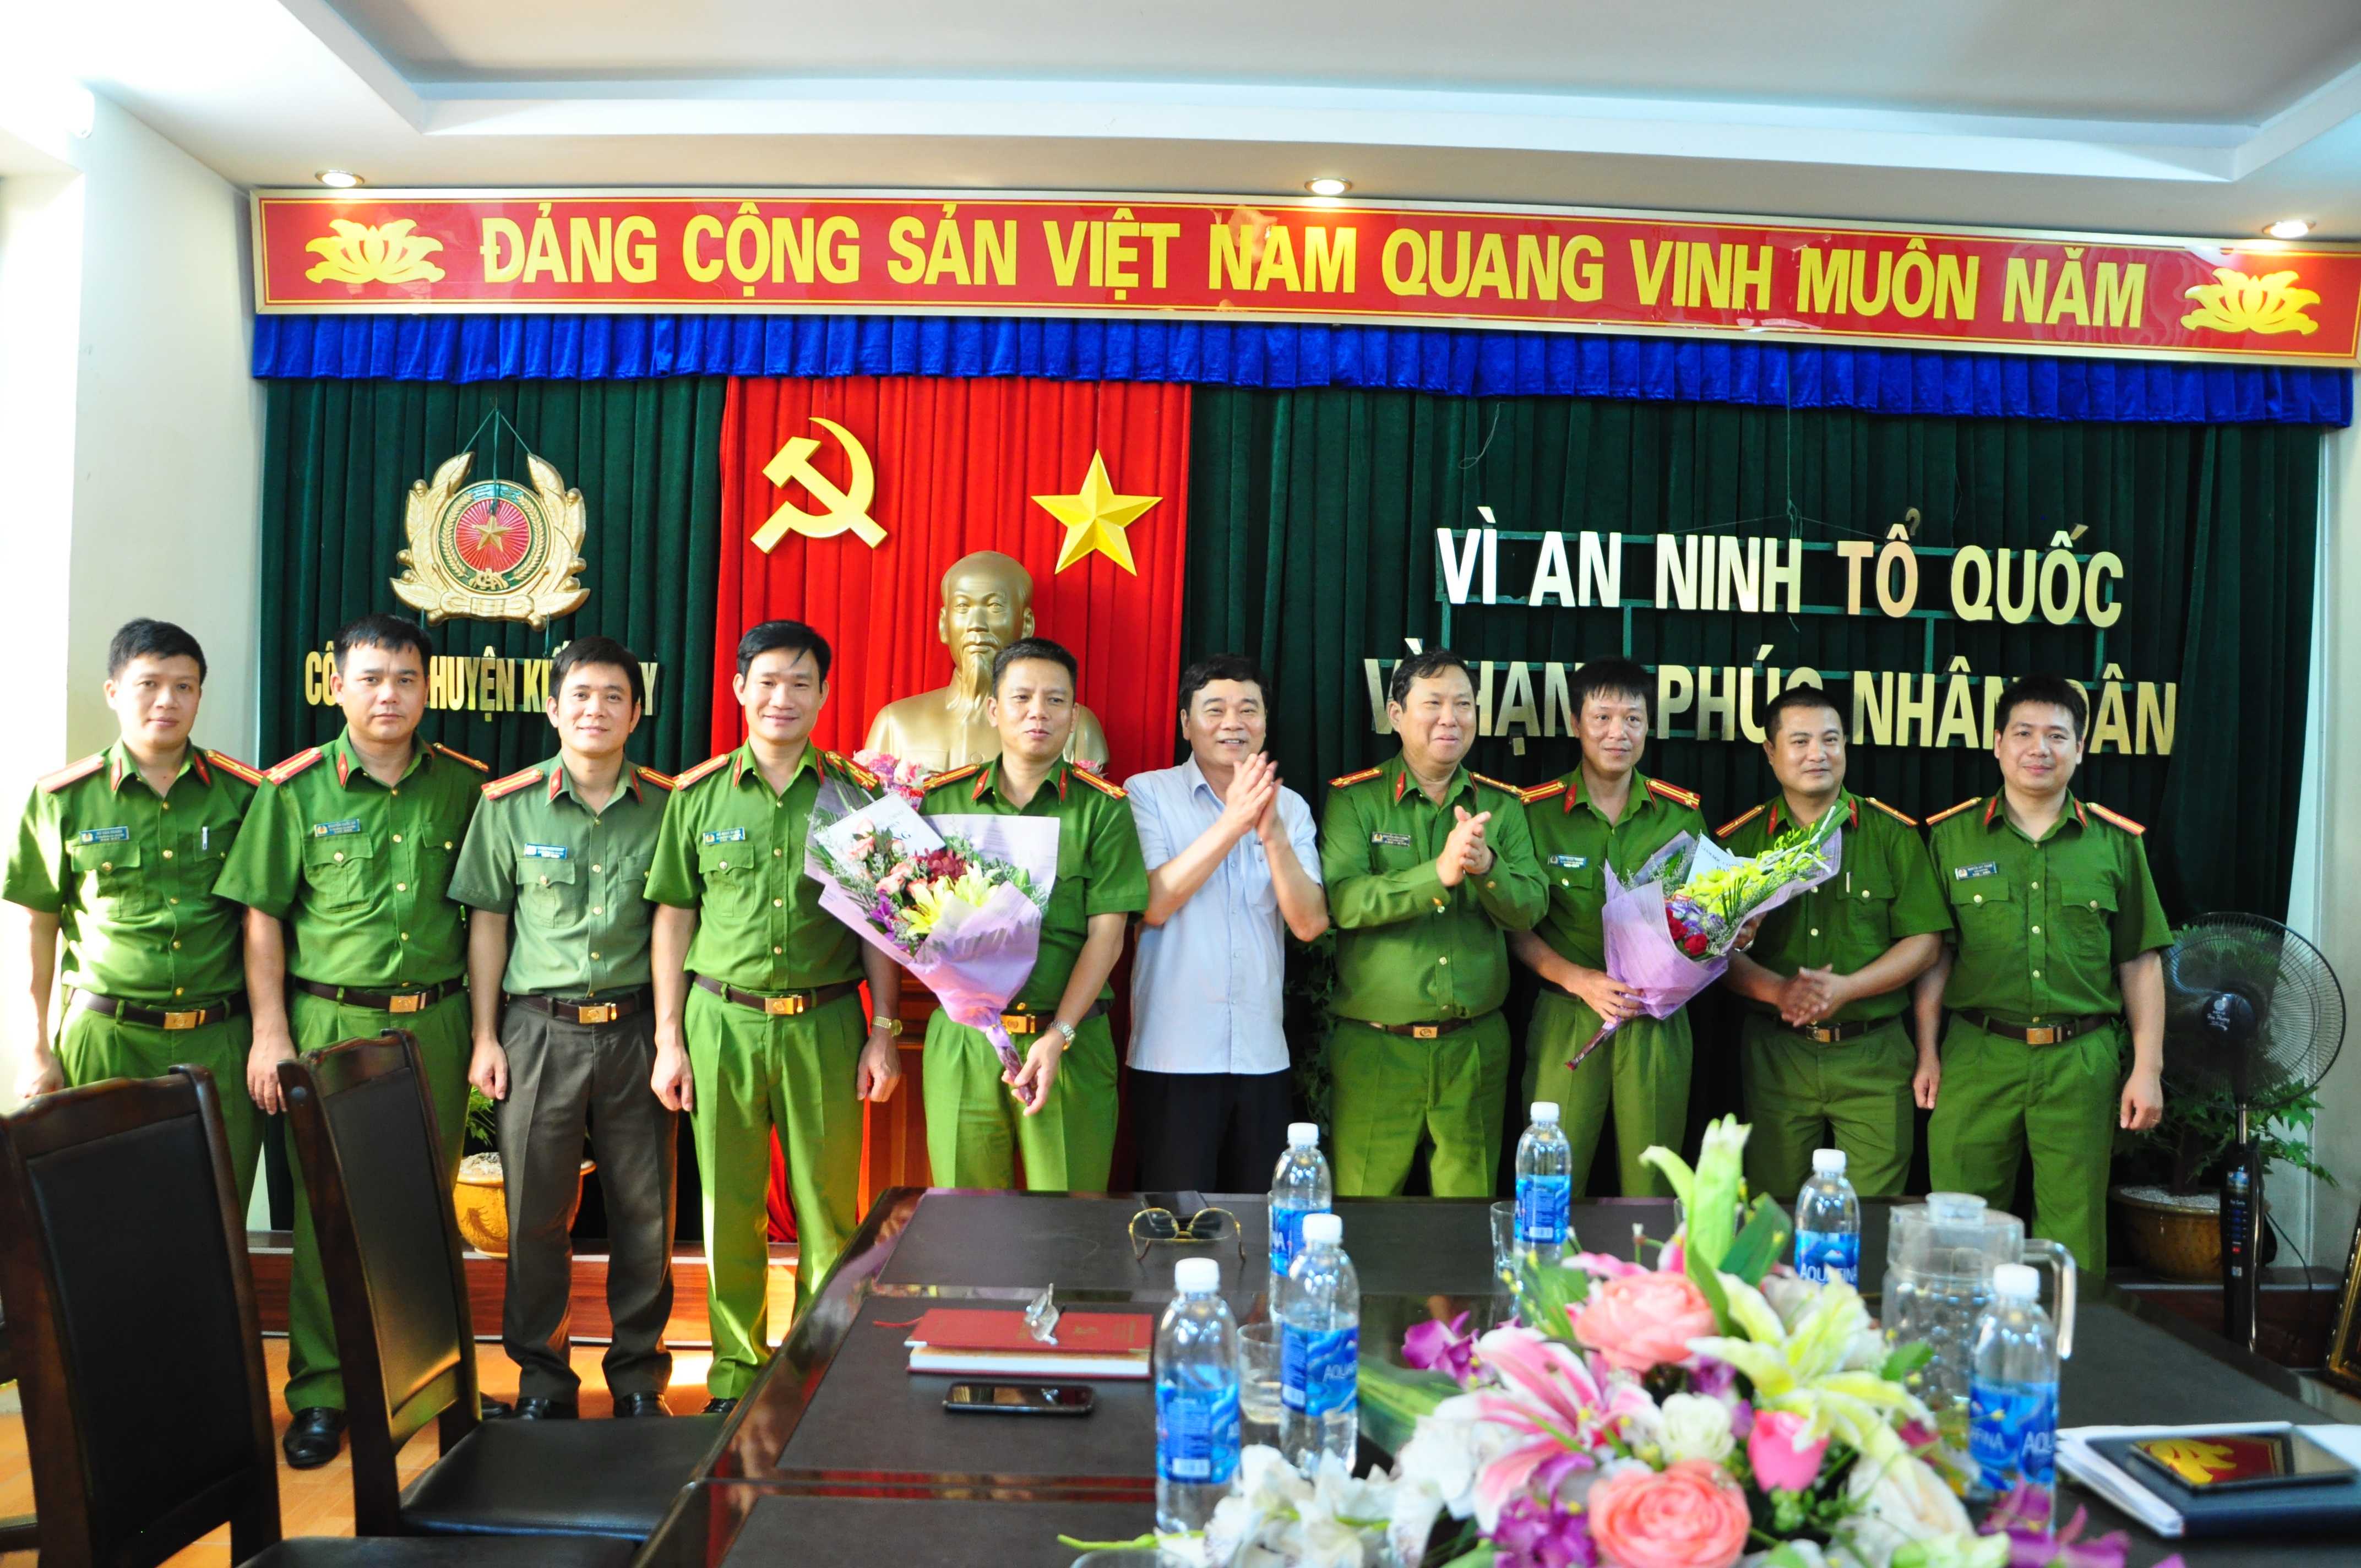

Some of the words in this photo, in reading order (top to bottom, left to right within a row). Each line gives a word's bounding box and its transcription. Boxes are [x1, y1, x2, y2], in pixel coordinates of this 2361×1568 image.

[480, 202, 657, 284] ĐẢNG
[683, 202, 860, 297] CỘNG
[887, 203, 1018, 285] SẢN
[1043, 208, 1180, 301] VIỆT
[1209, 224, 1357, 293] NAM
[1381, 227, 1604, 303] QUANG
[1629, 238, 1774, 311] VINH
[1796, 238, 1980, 320] MUÔN
[2001, 247, 2147, 328] NĂM
[1436, 506, 1498, 605] VÌ
[1528, 531, 1622, 607] AN
[1656, 533, 1802, 613] NINH
[1837, 507, 1921, 618] TỔ
[1950, 523, 2124, 628] QUỐC
[306, 640, 344, 706] CÔ
[429, 645, 515, 722] HUYỆN
